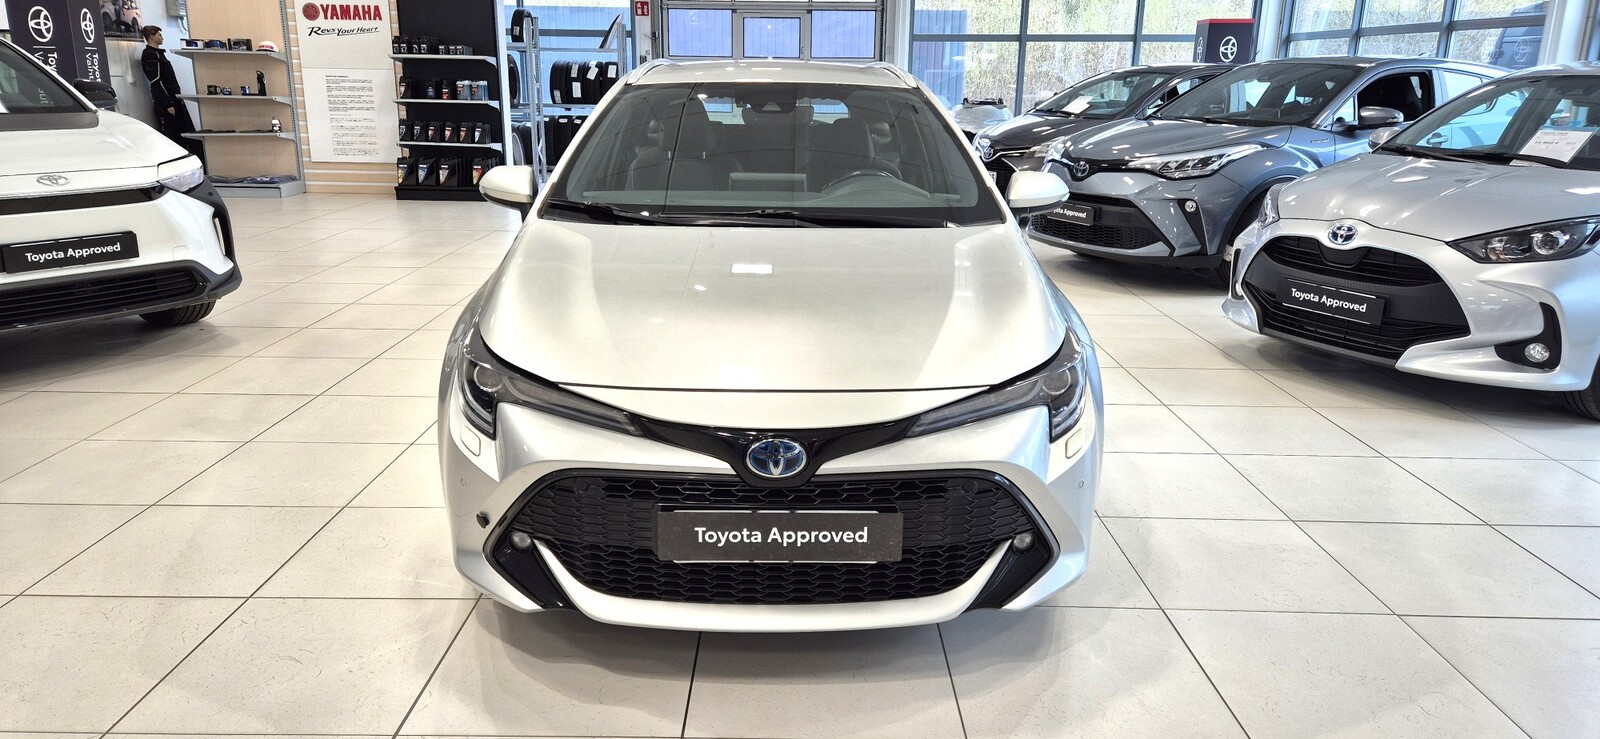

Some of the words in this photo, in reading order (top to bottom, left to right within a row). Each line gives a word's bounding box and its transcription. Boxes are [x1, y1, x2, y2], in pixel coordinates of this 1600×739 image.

[320, 4, 383, 21] YAMAHA
[307, 26, 336, 37] Revs
[336, 27, 356, 37] Your
[356, 26, 378, 34] Heart
[1063, 208, 1087, 218] Approved
[25, 250, 65, 263] Toyota
[67, 242, 121, 259] Approved
[1291, 287, 1320, 303] Toyota
[1320, 294, 1367, 313] Approved
[694, 526, 762, 547] Toyota
[767, 526, 868, 547] Approved
